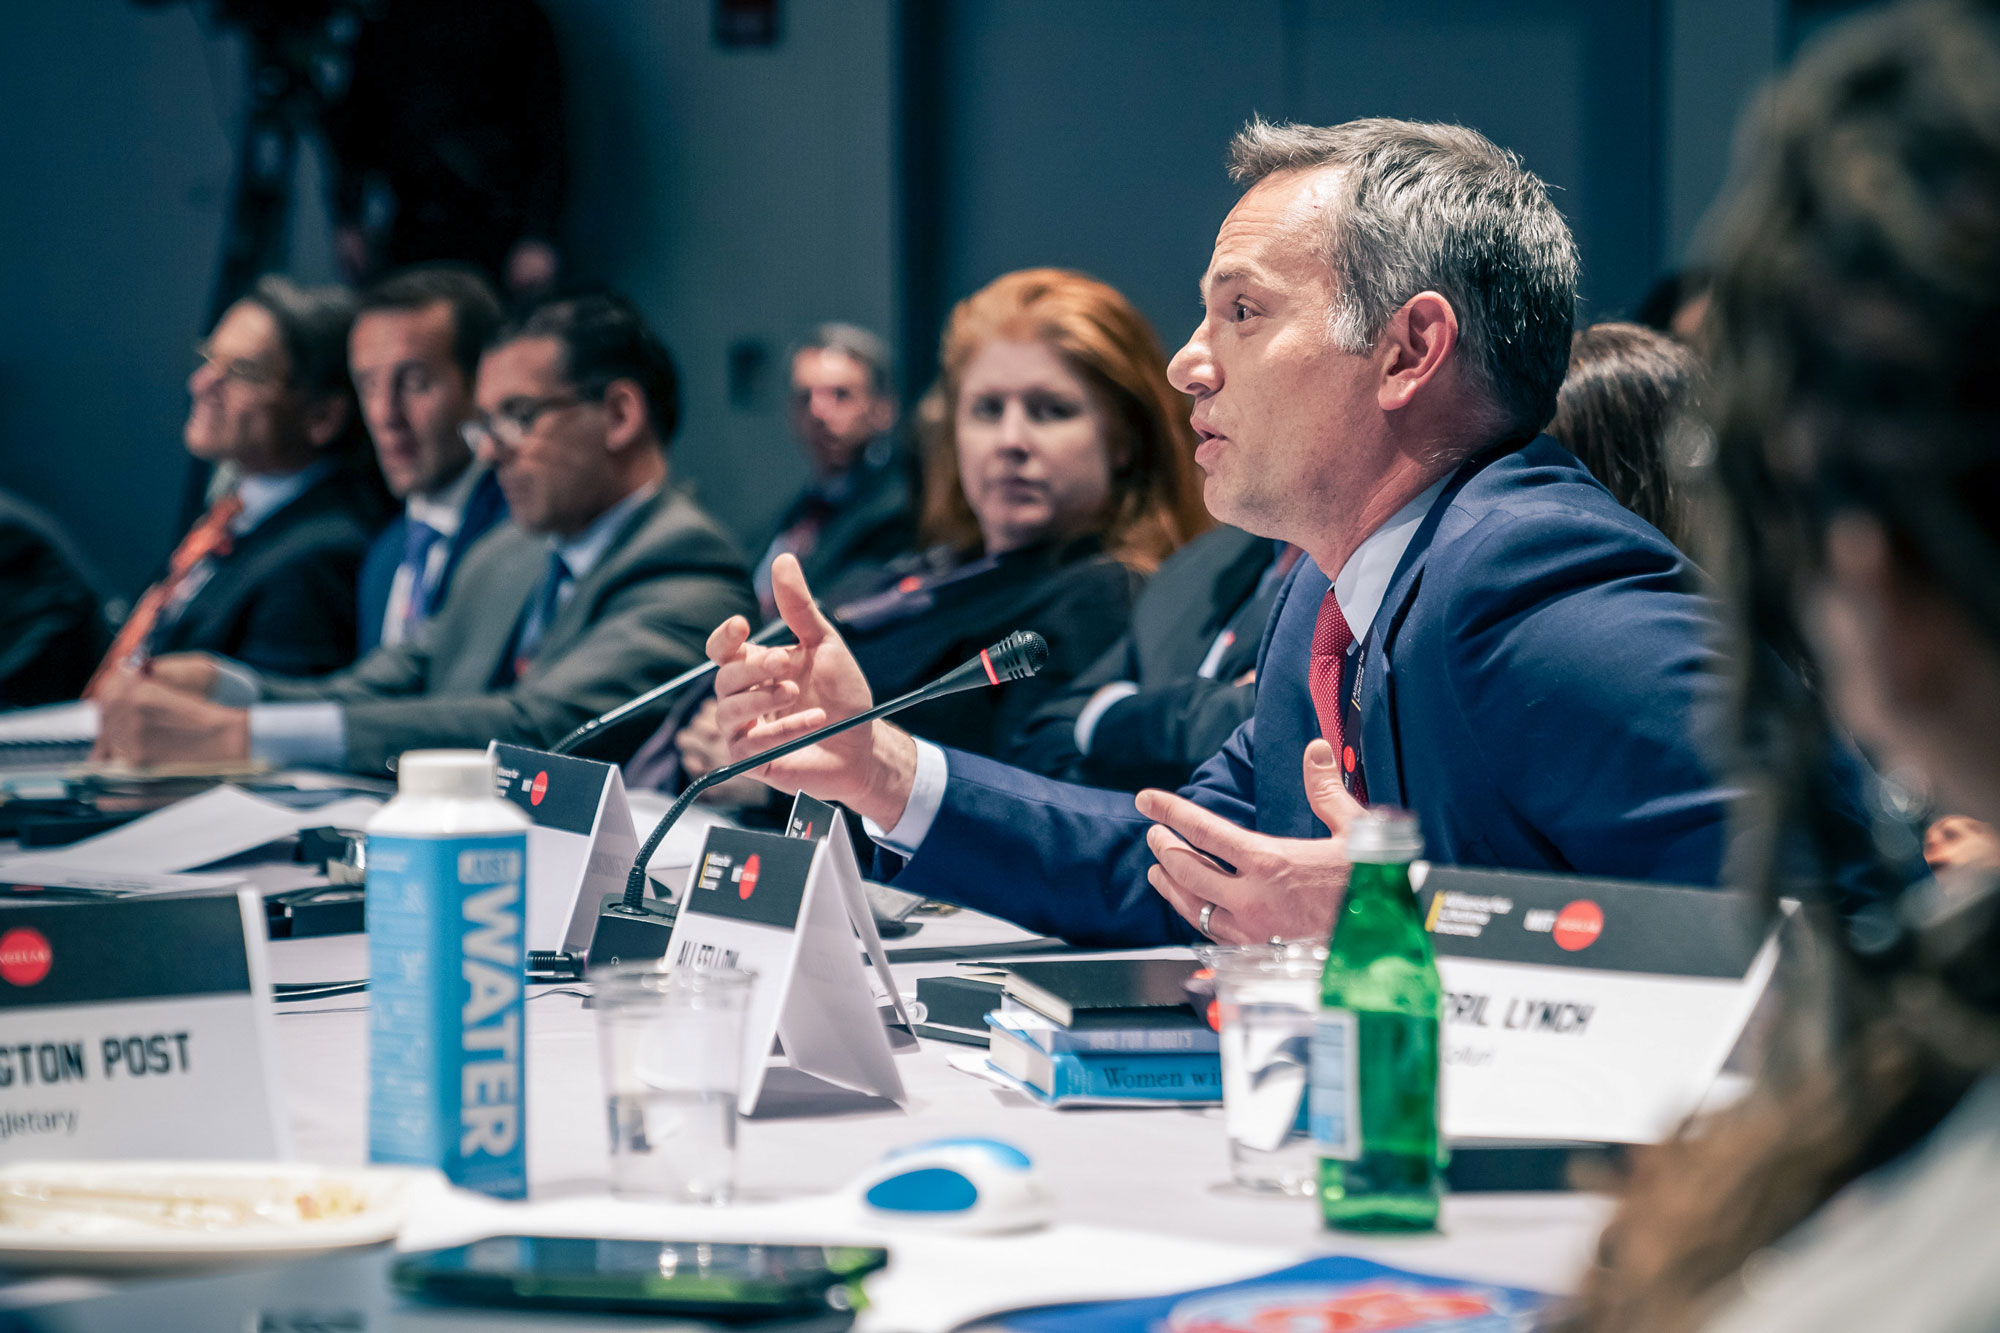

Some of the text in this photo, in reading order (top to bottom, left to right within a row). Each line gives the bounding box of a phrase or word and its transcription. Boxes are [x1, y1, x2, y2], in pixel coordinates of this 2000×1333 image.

[461, 882, 520, 1158] WATER
[1503, 996, 1595, 1034] LYNCH
[101, 1031, 190, 1080] POST
[1103, 1066, 1185, 1089] Women
